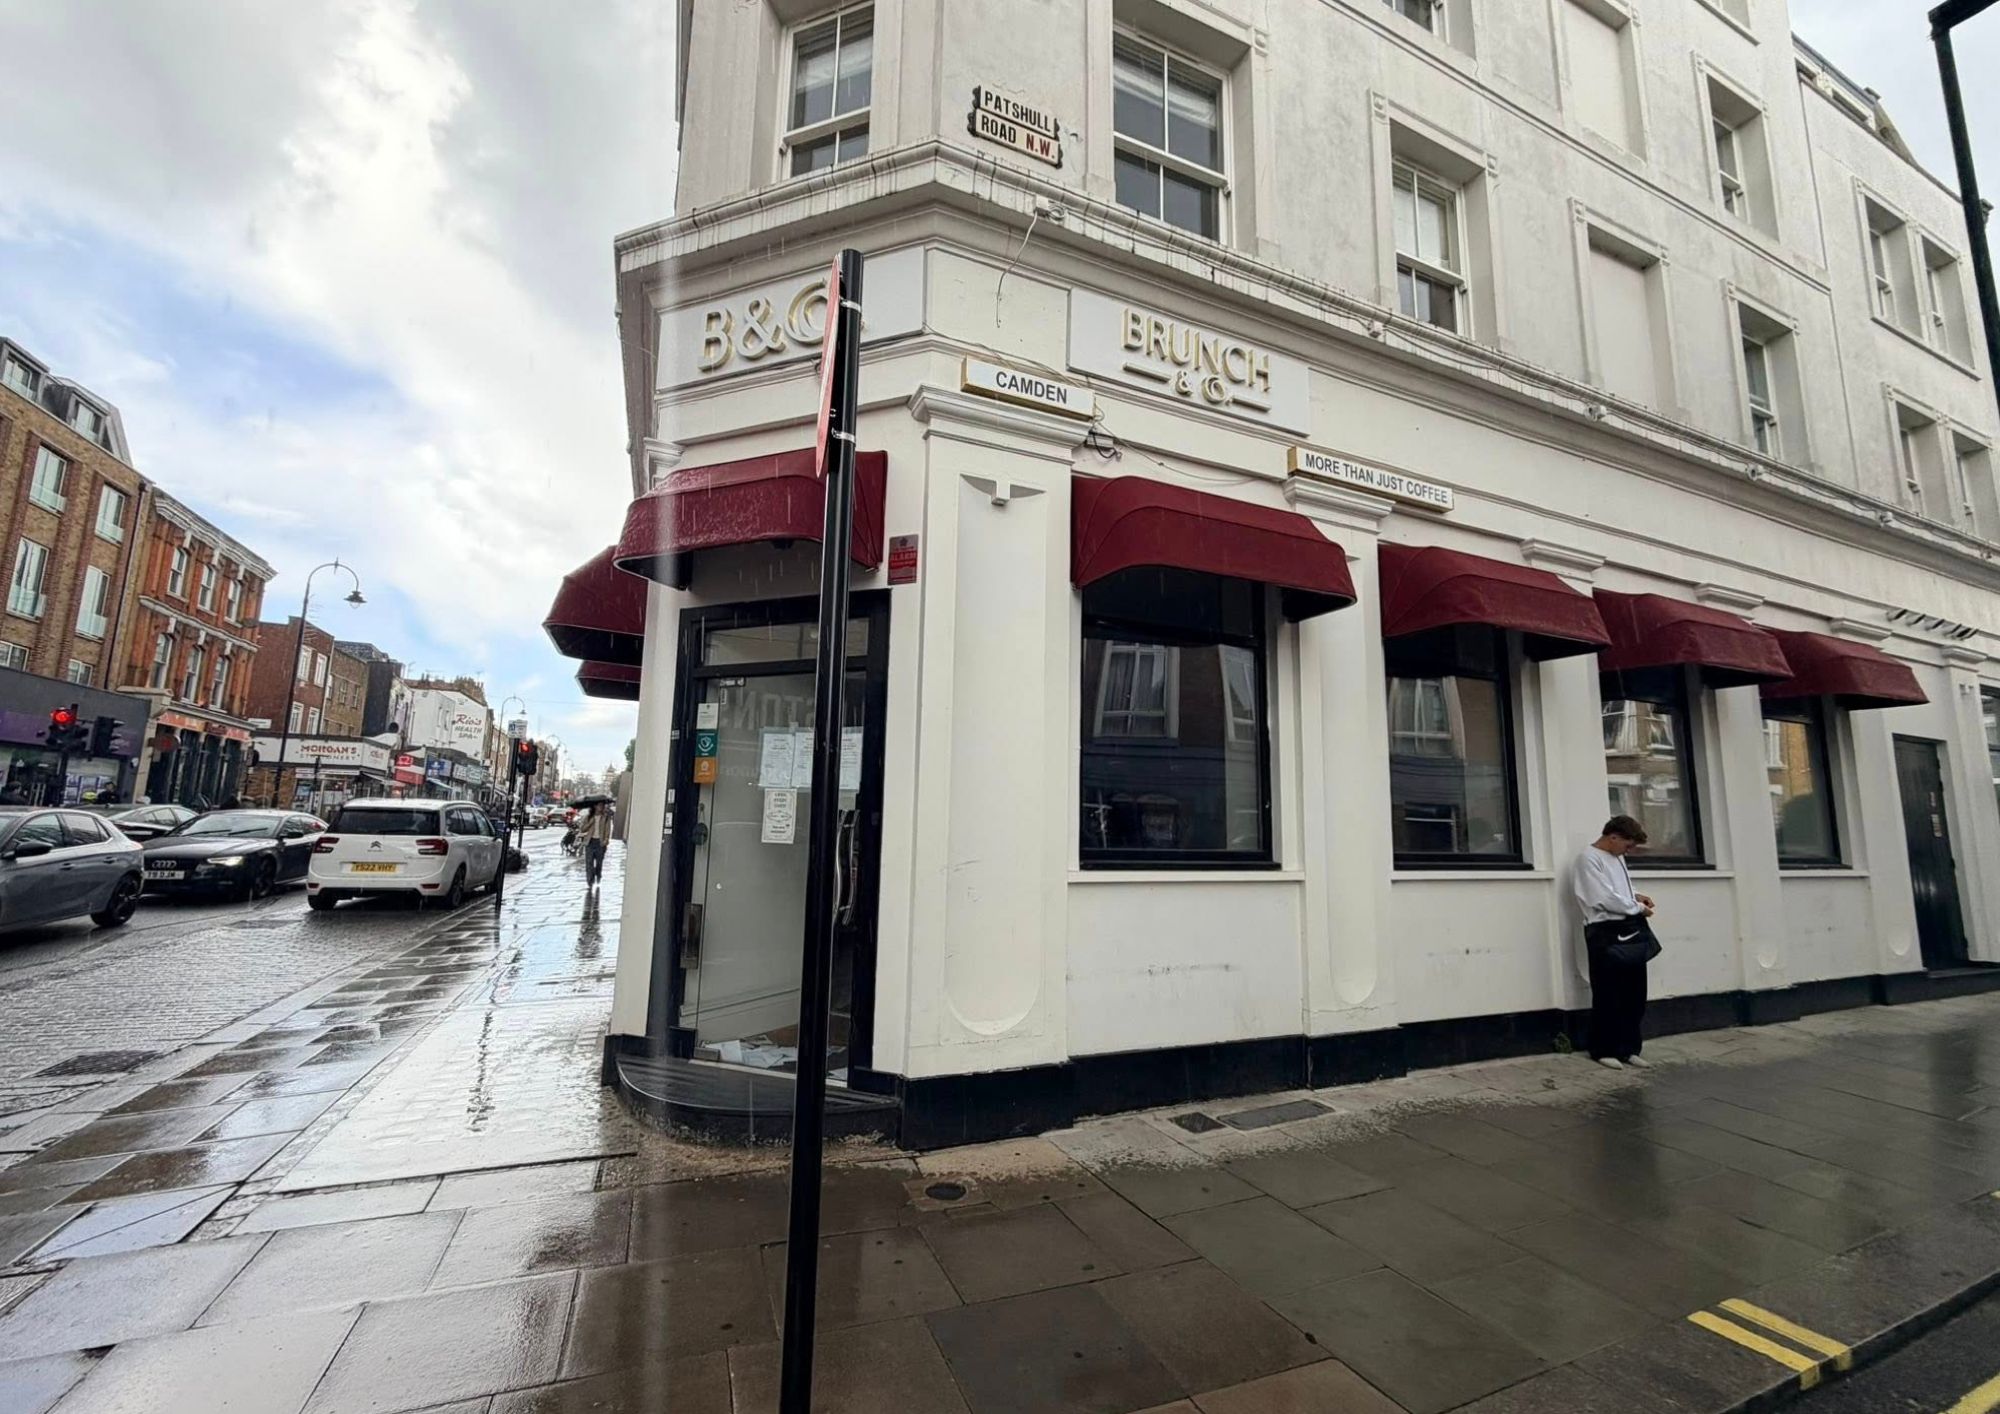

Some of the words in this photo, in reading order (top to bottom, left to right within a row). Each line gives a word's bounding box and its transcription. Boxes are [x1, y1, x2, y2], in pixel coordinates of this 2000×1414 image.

[984, 90, 1051, 133] PATSHULL
[981, 114, 1017, 144] ROAD
[1026, 133, 1056, 159] N.W.
[1121, 306, 1271, 393] BRUNCH
[995, 371, 1068, 405] CAMDEN
[1174, 370, 1194, 397] &
[1305, 453, 1341, 475] MORE
[1343, 463, 1374, 485] THAN
[1377, 473, 1404, 491] JUST
[1406, 480, 1448, 504] COFFEE
[455, 726, 482, 734] HEALTH
[300, 745, 357, 754] MORGAN'S
